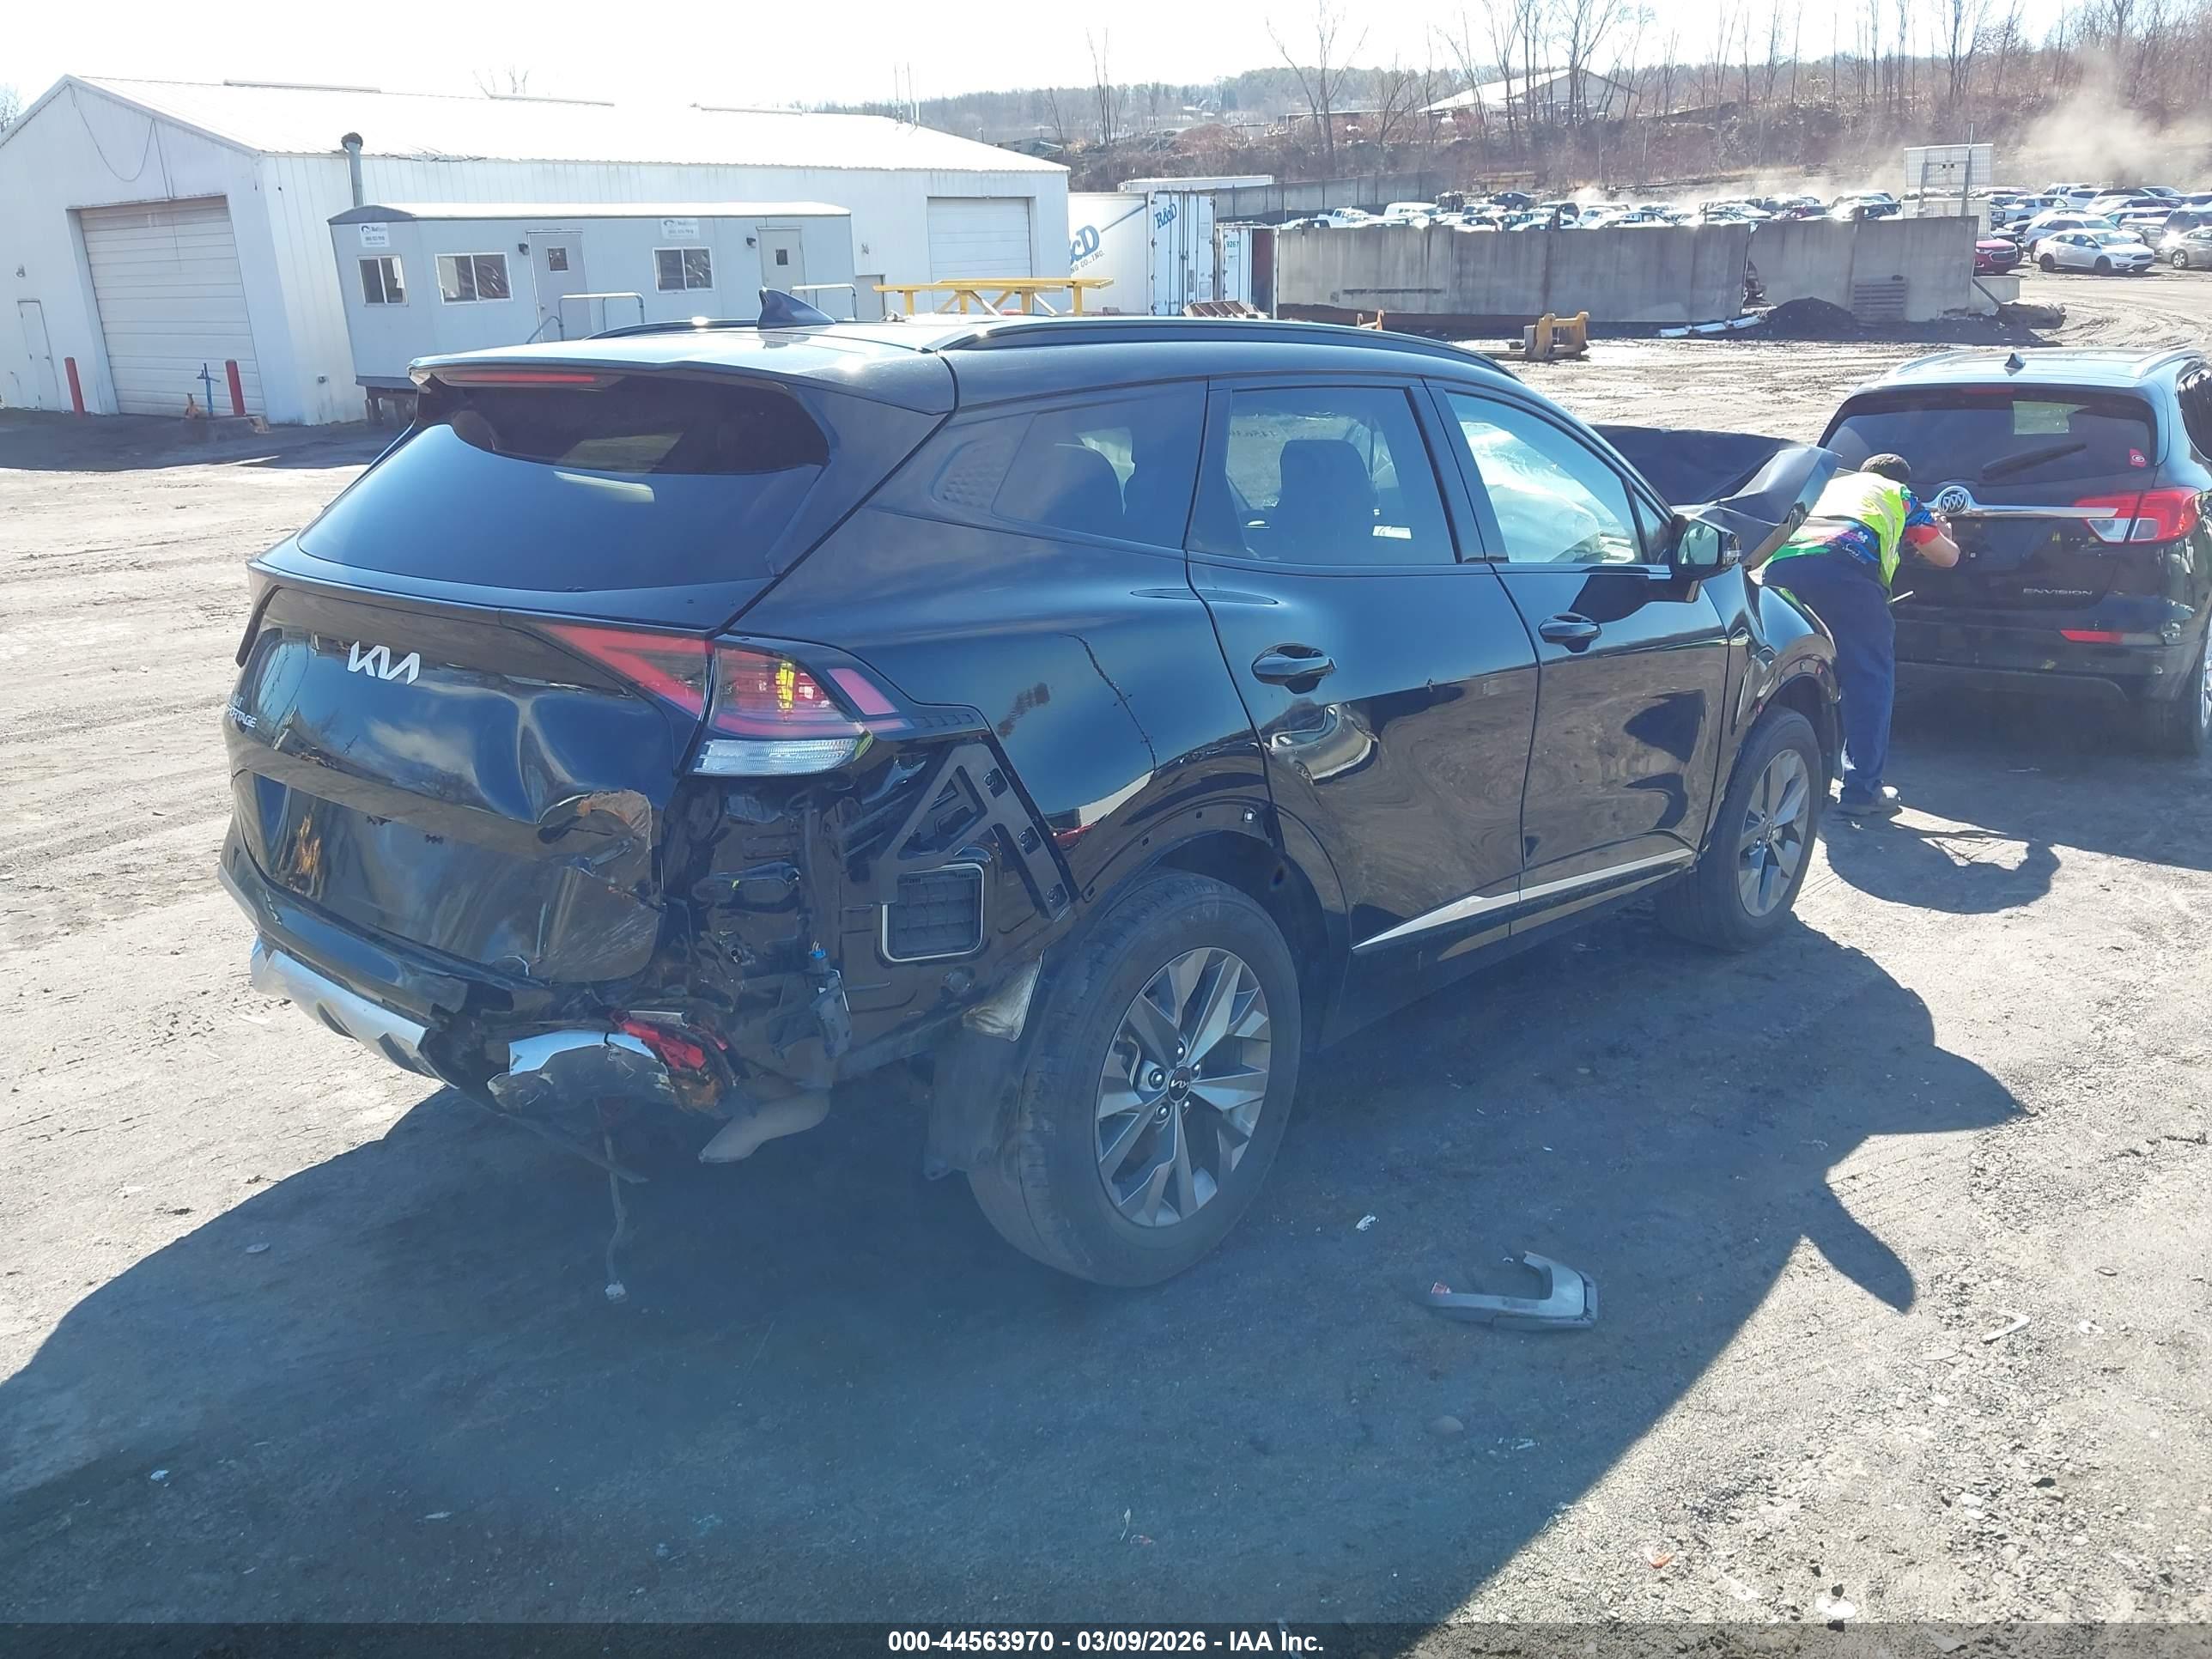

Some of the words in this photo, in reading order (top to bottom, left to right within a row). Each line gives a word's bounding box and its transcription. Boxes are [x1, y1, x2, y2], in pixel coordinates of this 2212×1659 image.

[1155, 204, 1178, 229] R&D
[2023, 587, 2094, 596] ENVISION
[347, 640, 421, 685] KIA
